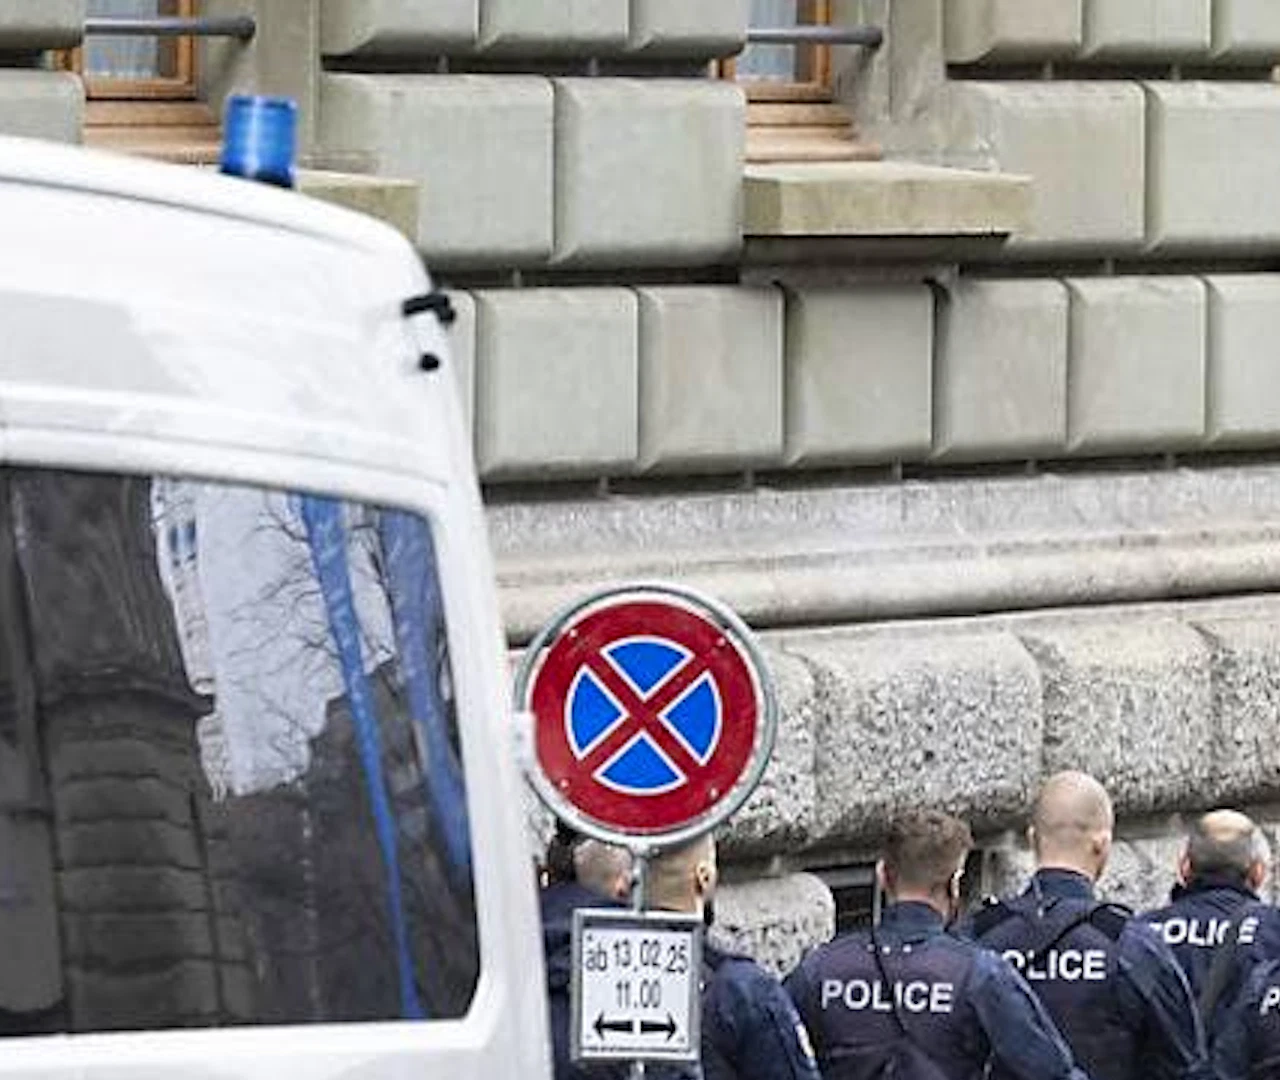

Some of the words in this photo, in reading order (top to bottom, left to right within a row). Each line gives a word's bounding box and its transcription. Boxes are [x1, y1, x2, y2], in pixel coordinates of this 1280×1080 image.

[1148, 917, 1260, 946] OLICE
[586, 941, 608, 971] ab
[615, 978, 661, 1009] 11.00
[821, 979, 954, 1013] POLICE
